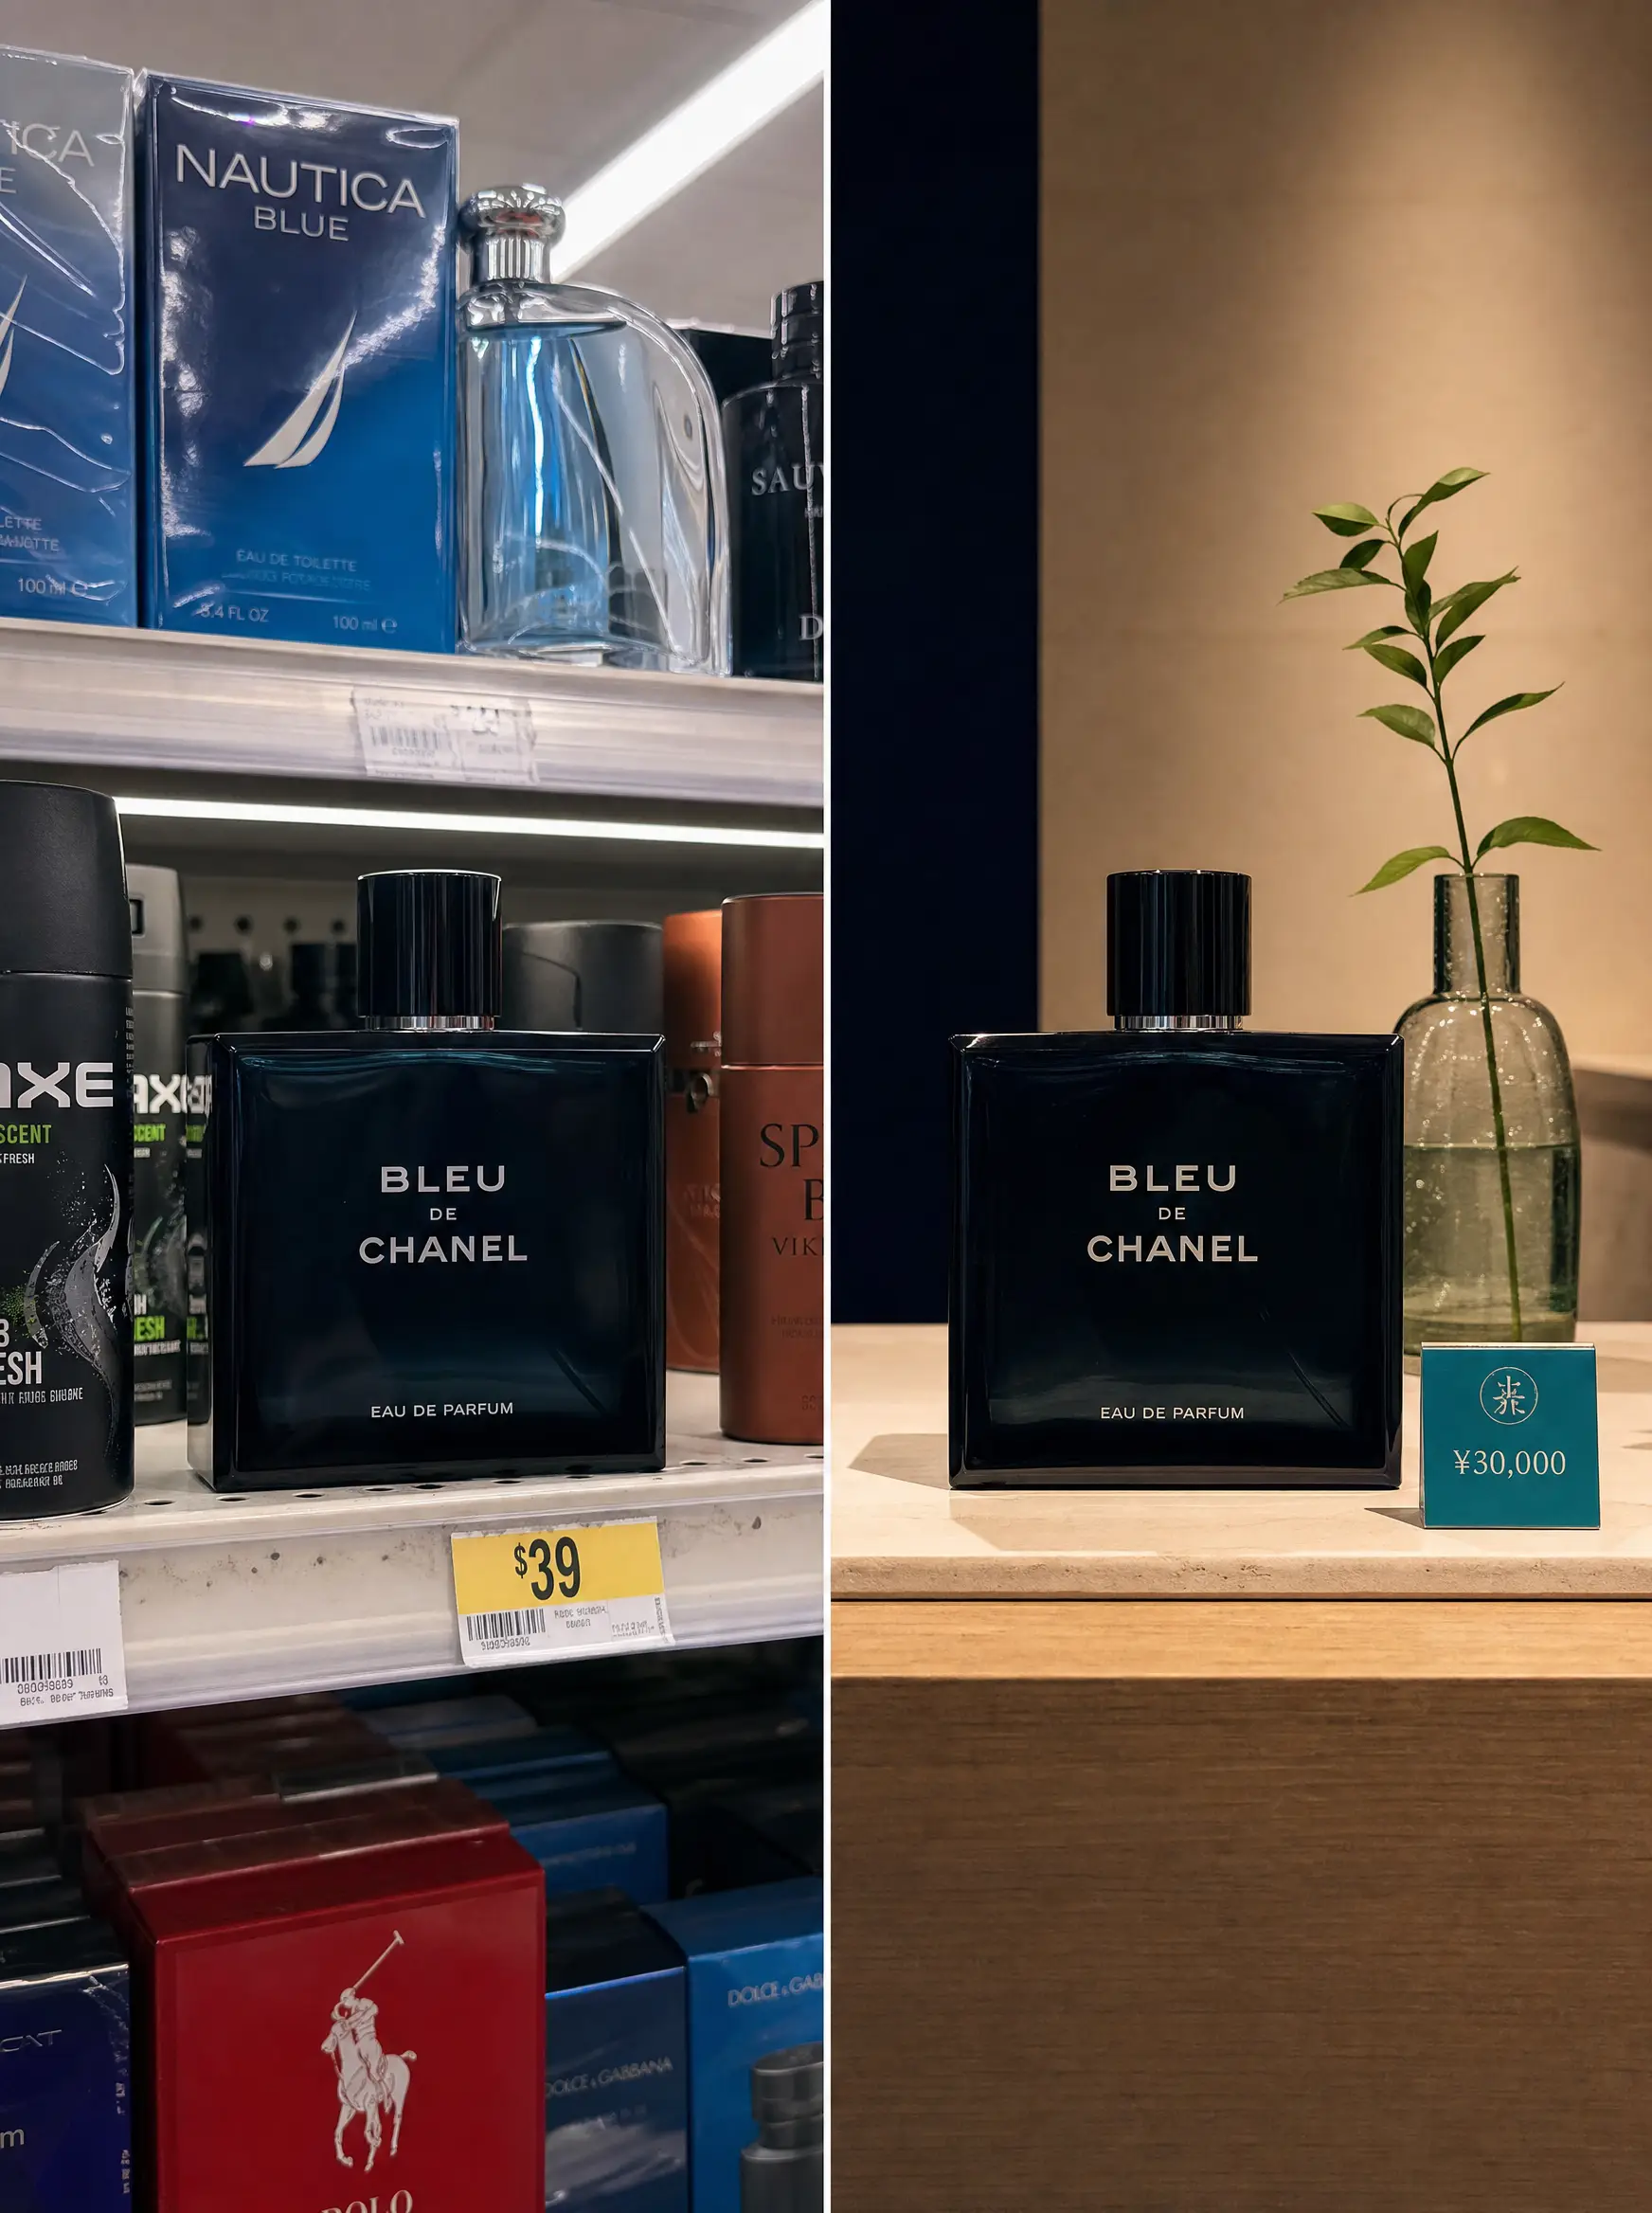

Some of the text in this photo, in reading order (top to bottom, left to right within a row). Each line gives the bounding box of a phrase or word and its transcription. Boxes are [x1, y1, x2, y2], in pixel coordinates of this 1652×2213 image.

[0, 119, 94, 167] ICA
[176, 144, 426, 219] NAUTICA
[254, 207, 350, 242] BLUE
[237, 549, 358, 572] EAU DE TOILETTE
[18, 578, 46, 594] 100
[228, 605, 244, 621] FL
[248, 607, 269, 622] OZ
[333, 616, 358, 630] 100
[0, 1062, 114, 1108] XE
[381, 1165, 505, 1193] BLEU
[1109, 1165, 1236, 1192] BLEU
[430, 1208, 457, 1220] DE
[1158, 1207, 1186, 1220] DE
[359, 1234, 528, 1264] CHANEL
[1087, 1235, 1258, 1262] CHANEL
[370, 1402, 513, 1418] EAU DE PARFUM
[1101, 1407, 1244, 1419] EAU DE PARFUM
[1453, 1449, 1566, 1479] ¥30,000
[513, 1537, 581, 1600] $39
